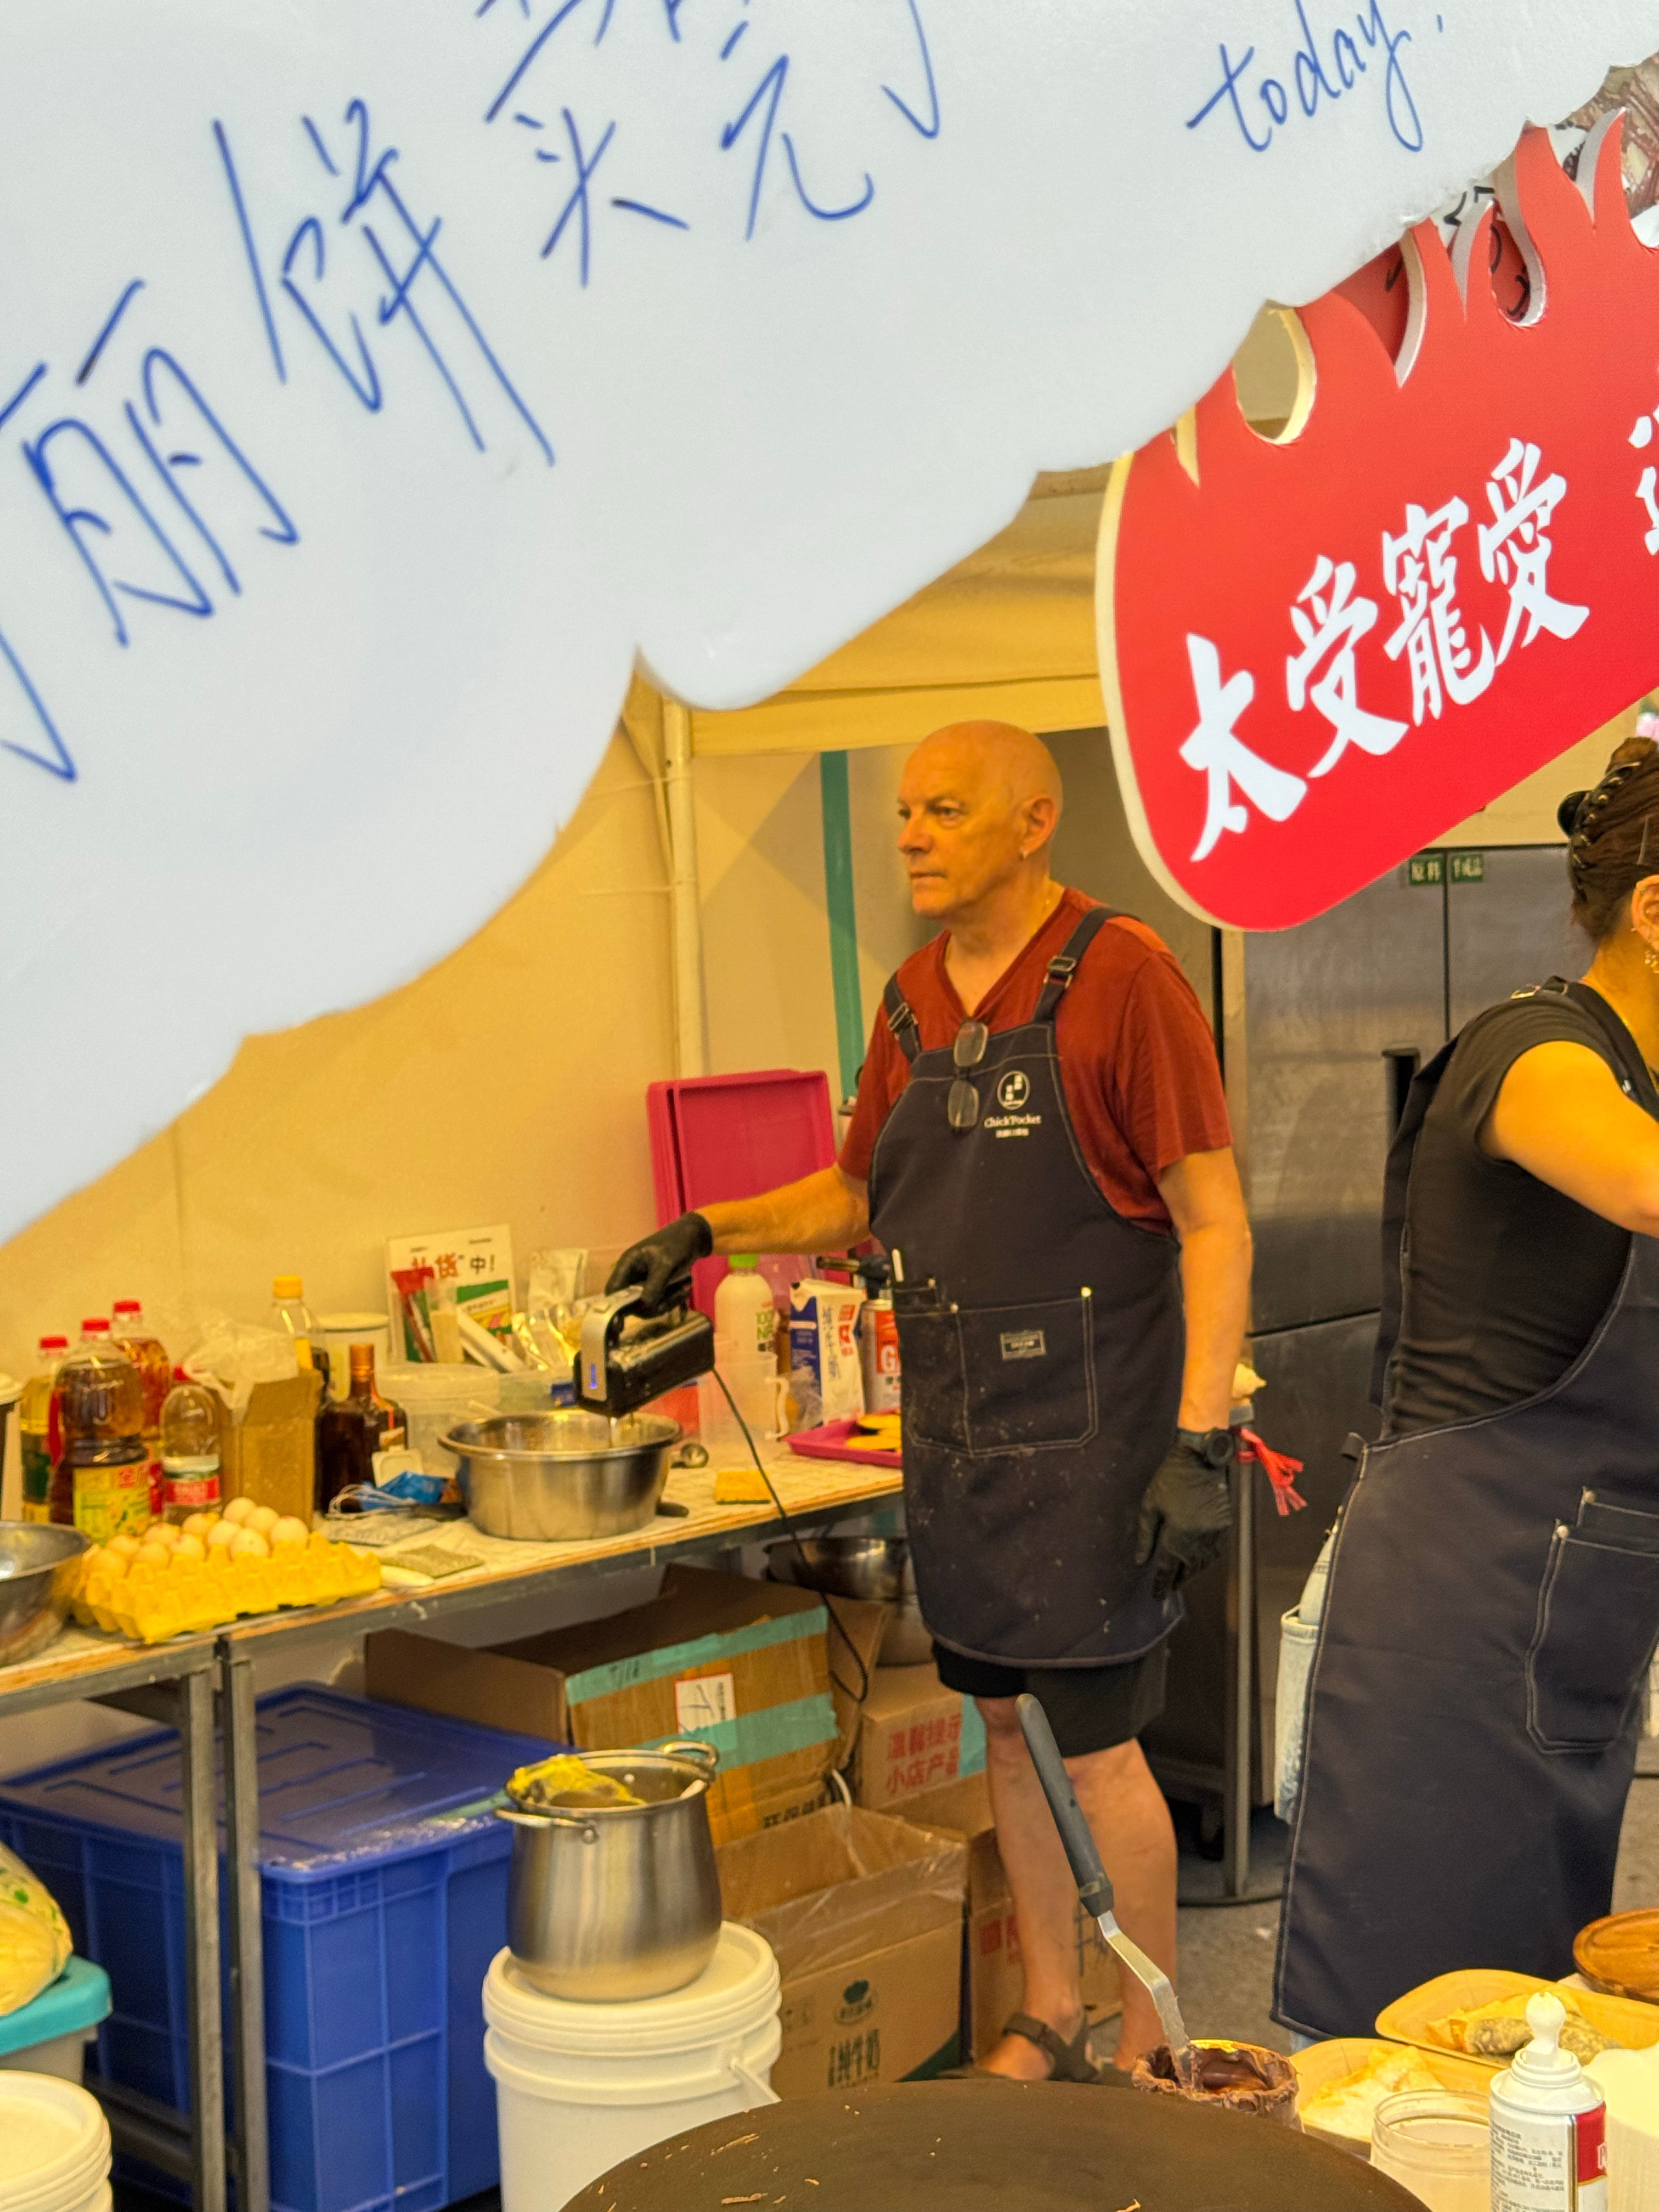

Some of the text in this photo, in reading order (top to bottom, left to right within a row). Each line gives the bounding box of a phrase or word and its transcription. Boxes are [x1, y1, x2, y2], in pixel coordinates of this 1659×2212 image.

[1186, 0, 1443, 152] today
[1179, 437, 1590, 862] 太受寵愛
